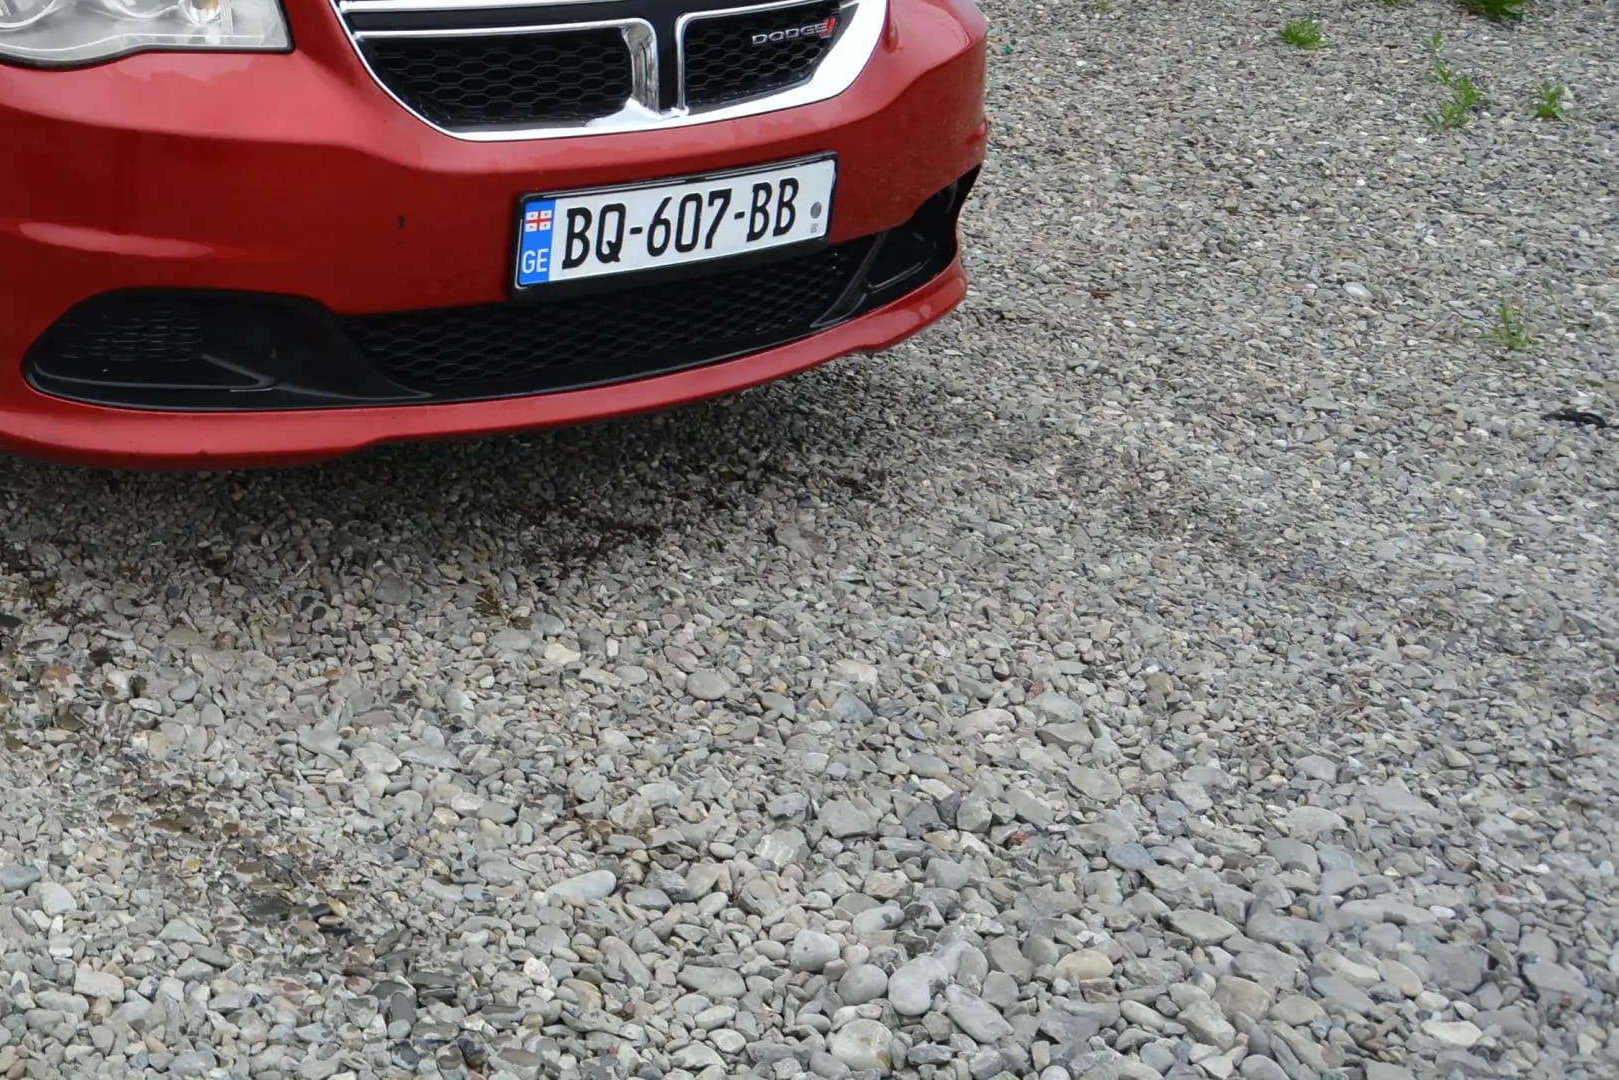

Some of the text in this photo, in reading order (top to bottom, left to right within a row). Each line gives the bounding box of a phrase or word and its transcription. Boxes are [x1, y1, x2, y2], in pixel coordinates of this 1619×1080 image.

[751, 22, 828, 45] DODGE
[522, 177, 800, 274] GE BQ-607-BB
